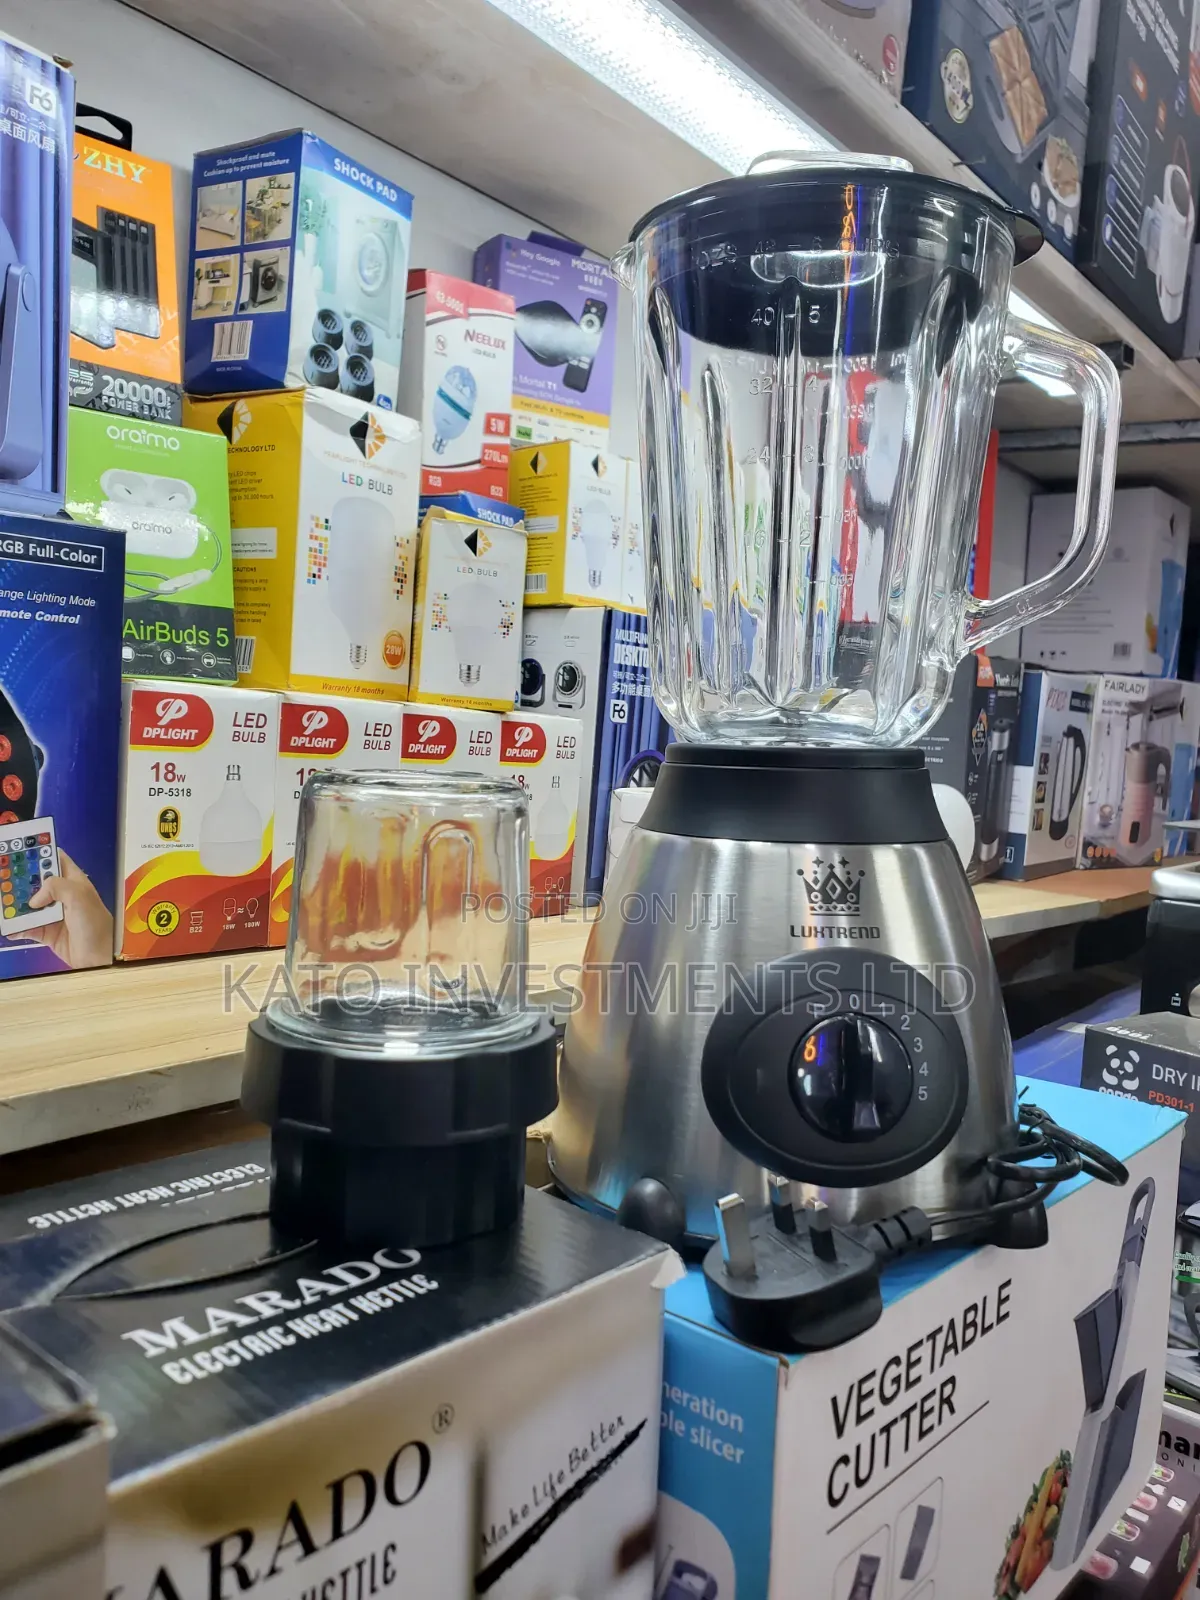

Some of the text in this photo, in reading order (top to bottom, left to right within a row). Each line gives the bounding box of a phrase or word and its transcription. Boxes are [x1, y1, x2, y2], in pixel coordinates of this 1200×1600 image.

[29, 84, 54, 112] F6
[84, 146, 147, 184] ZHY
[216, 154, 248, 167] Shockproof
[248, 152, 260, 161] and
[203, 166, 225, 178] Cushion
[334, 158, 399, 202] SHOCK PAD
[535, 253, 561, 267] Google
[751, 304, 821, 326] 40 5
[101, 375, 167, 408] 20000
[101, 395, 172, 421] POWER BANK
[490, 417, 505, 432] 5W
[106, 425, 181, 451] oraimo
[264, 444, 276, 452] LTD
[341, 471, 394, 496] LED BULB
[478, 508, 501, 524] SHOCK
[501, 513, 514, 527] PAD
[131, 521, 173, 535] oraimo
[29, 543, 97, 564] Full-Color
[456, 566, 498, 578] LED BULB
[27, 590, 67, 606] Lighting
[69, 594, 96, 607] Mode
[35, 611, 80, 625] Control
[123, 618, 230, 647] AirBuds 5
[322, 682, 385, 695] Warranty 18 months
[1104, 679, 1146, 695] FAIRLADY
[440, 697, 465, 705] Warranty
[612, 703, 626, 719] F6
[232, 711, 267, 729] LED
[142, 728, 198, 742] DPLIGHT
[231, 731, 266, 744] BULB
[363, 722, 393, 738] LED
[469, 730, 493, 745] LED
[290, 736, 336, 749] DPLIGHT
[363, 739, 391, 751] BULB
[408, 743, 446, 755] DPLIGHT
[556, 735, 577, 749] LED
[468, 745, 492, 756] BULB
[505, 748, 538, 759] DPLIGHT
[556, 750, 575, 760] BULB
[148, 787, 192, 799] DP-5318
[161, 822, 177, 833] UNBS
[151, 902, 176, 915] Warranty
[160, 913, 168, 925] 2
[189, 926, 203, 934] B22
[790, 925, 881, 939] LUXTREND
[849, 994, 860, 1010] 0
[878, 1002, 888, 1017] 1
[900, 1015, 911, 1030] 2
[913, 1037, 924, 1052] 3
[918, 1062, 929, 1077] 4
[1152, 1063, 1188, 1087] DRY
[918, 1086, 928, 1101] 5
[1148, 1090, 1195, 1113] PD301-1
[170, 1163, 266, 1195] ELECTRIC
[113, 1183, 174, 1209] HEAT
[121, 1248, 422, 1358] MARADO
[161, 1325, 297, 1385] ELECTRIC
[291, 1294, 360, 1340] HEAT
[831, 1278, 1012, 1439] VEGETABLE
[690, 1424, 745, 1464] slicer
[827, 1375, 956, 1508] CUTTER
[482, 1414, 626, 1556] Make Life Better
[105, 1440, 431, 1600] ARADO
